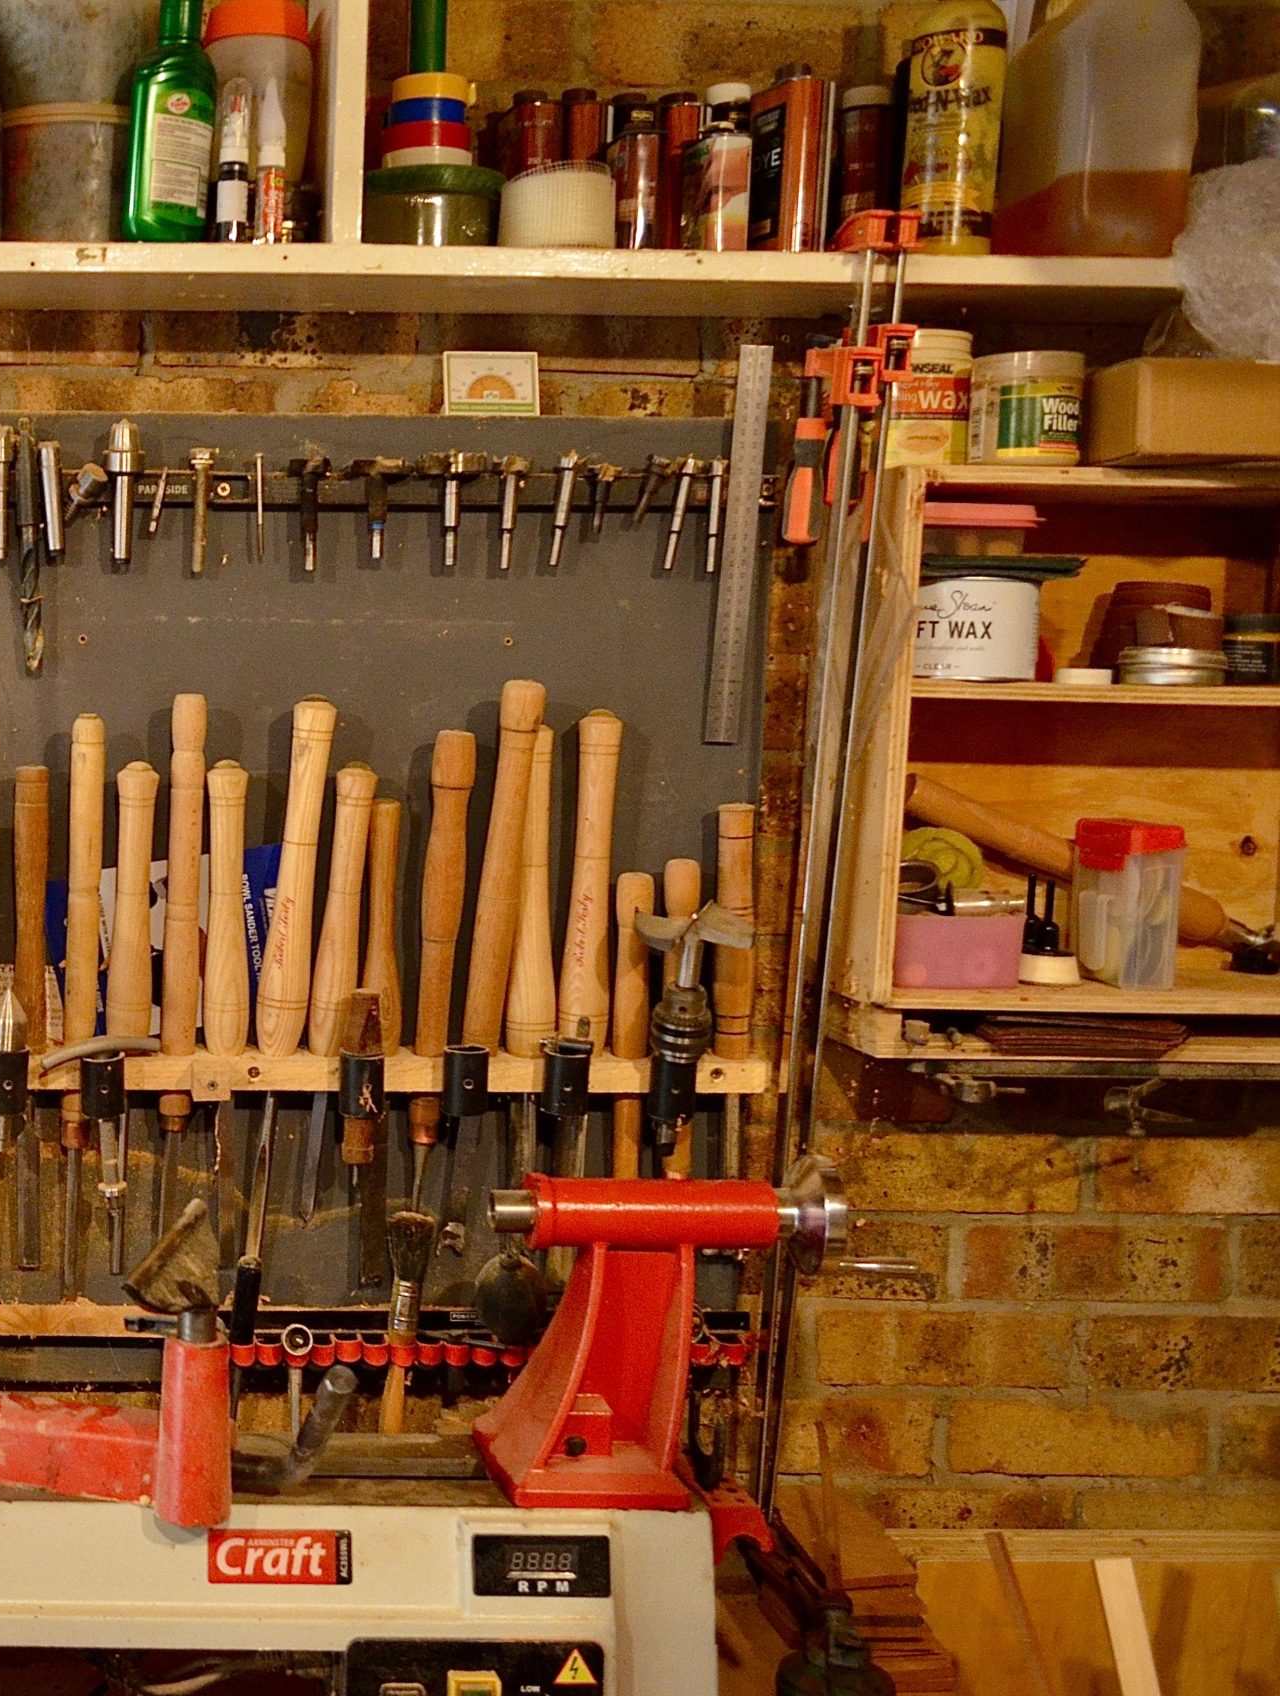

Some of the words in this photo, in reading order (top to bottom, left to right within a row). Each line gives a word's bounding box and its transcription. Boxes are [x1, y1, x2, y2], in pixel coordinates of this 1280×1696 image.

[918, 390, 969, 410] wax
[1042, 398, 1079, 416] Wood
[1043, 414, 1079, 431] Filler
[138, 484, 188, 495] PARSIDE
[917, 620, 940, 638] FT
[948, 620, 993, 639] WAX
[244, 903, 259, 944] SANDER
[251, 943, 264, 972] TOOL
[216, 1536, 327, 1576] Craft
[520, 1685, 541, 1693] LOW
